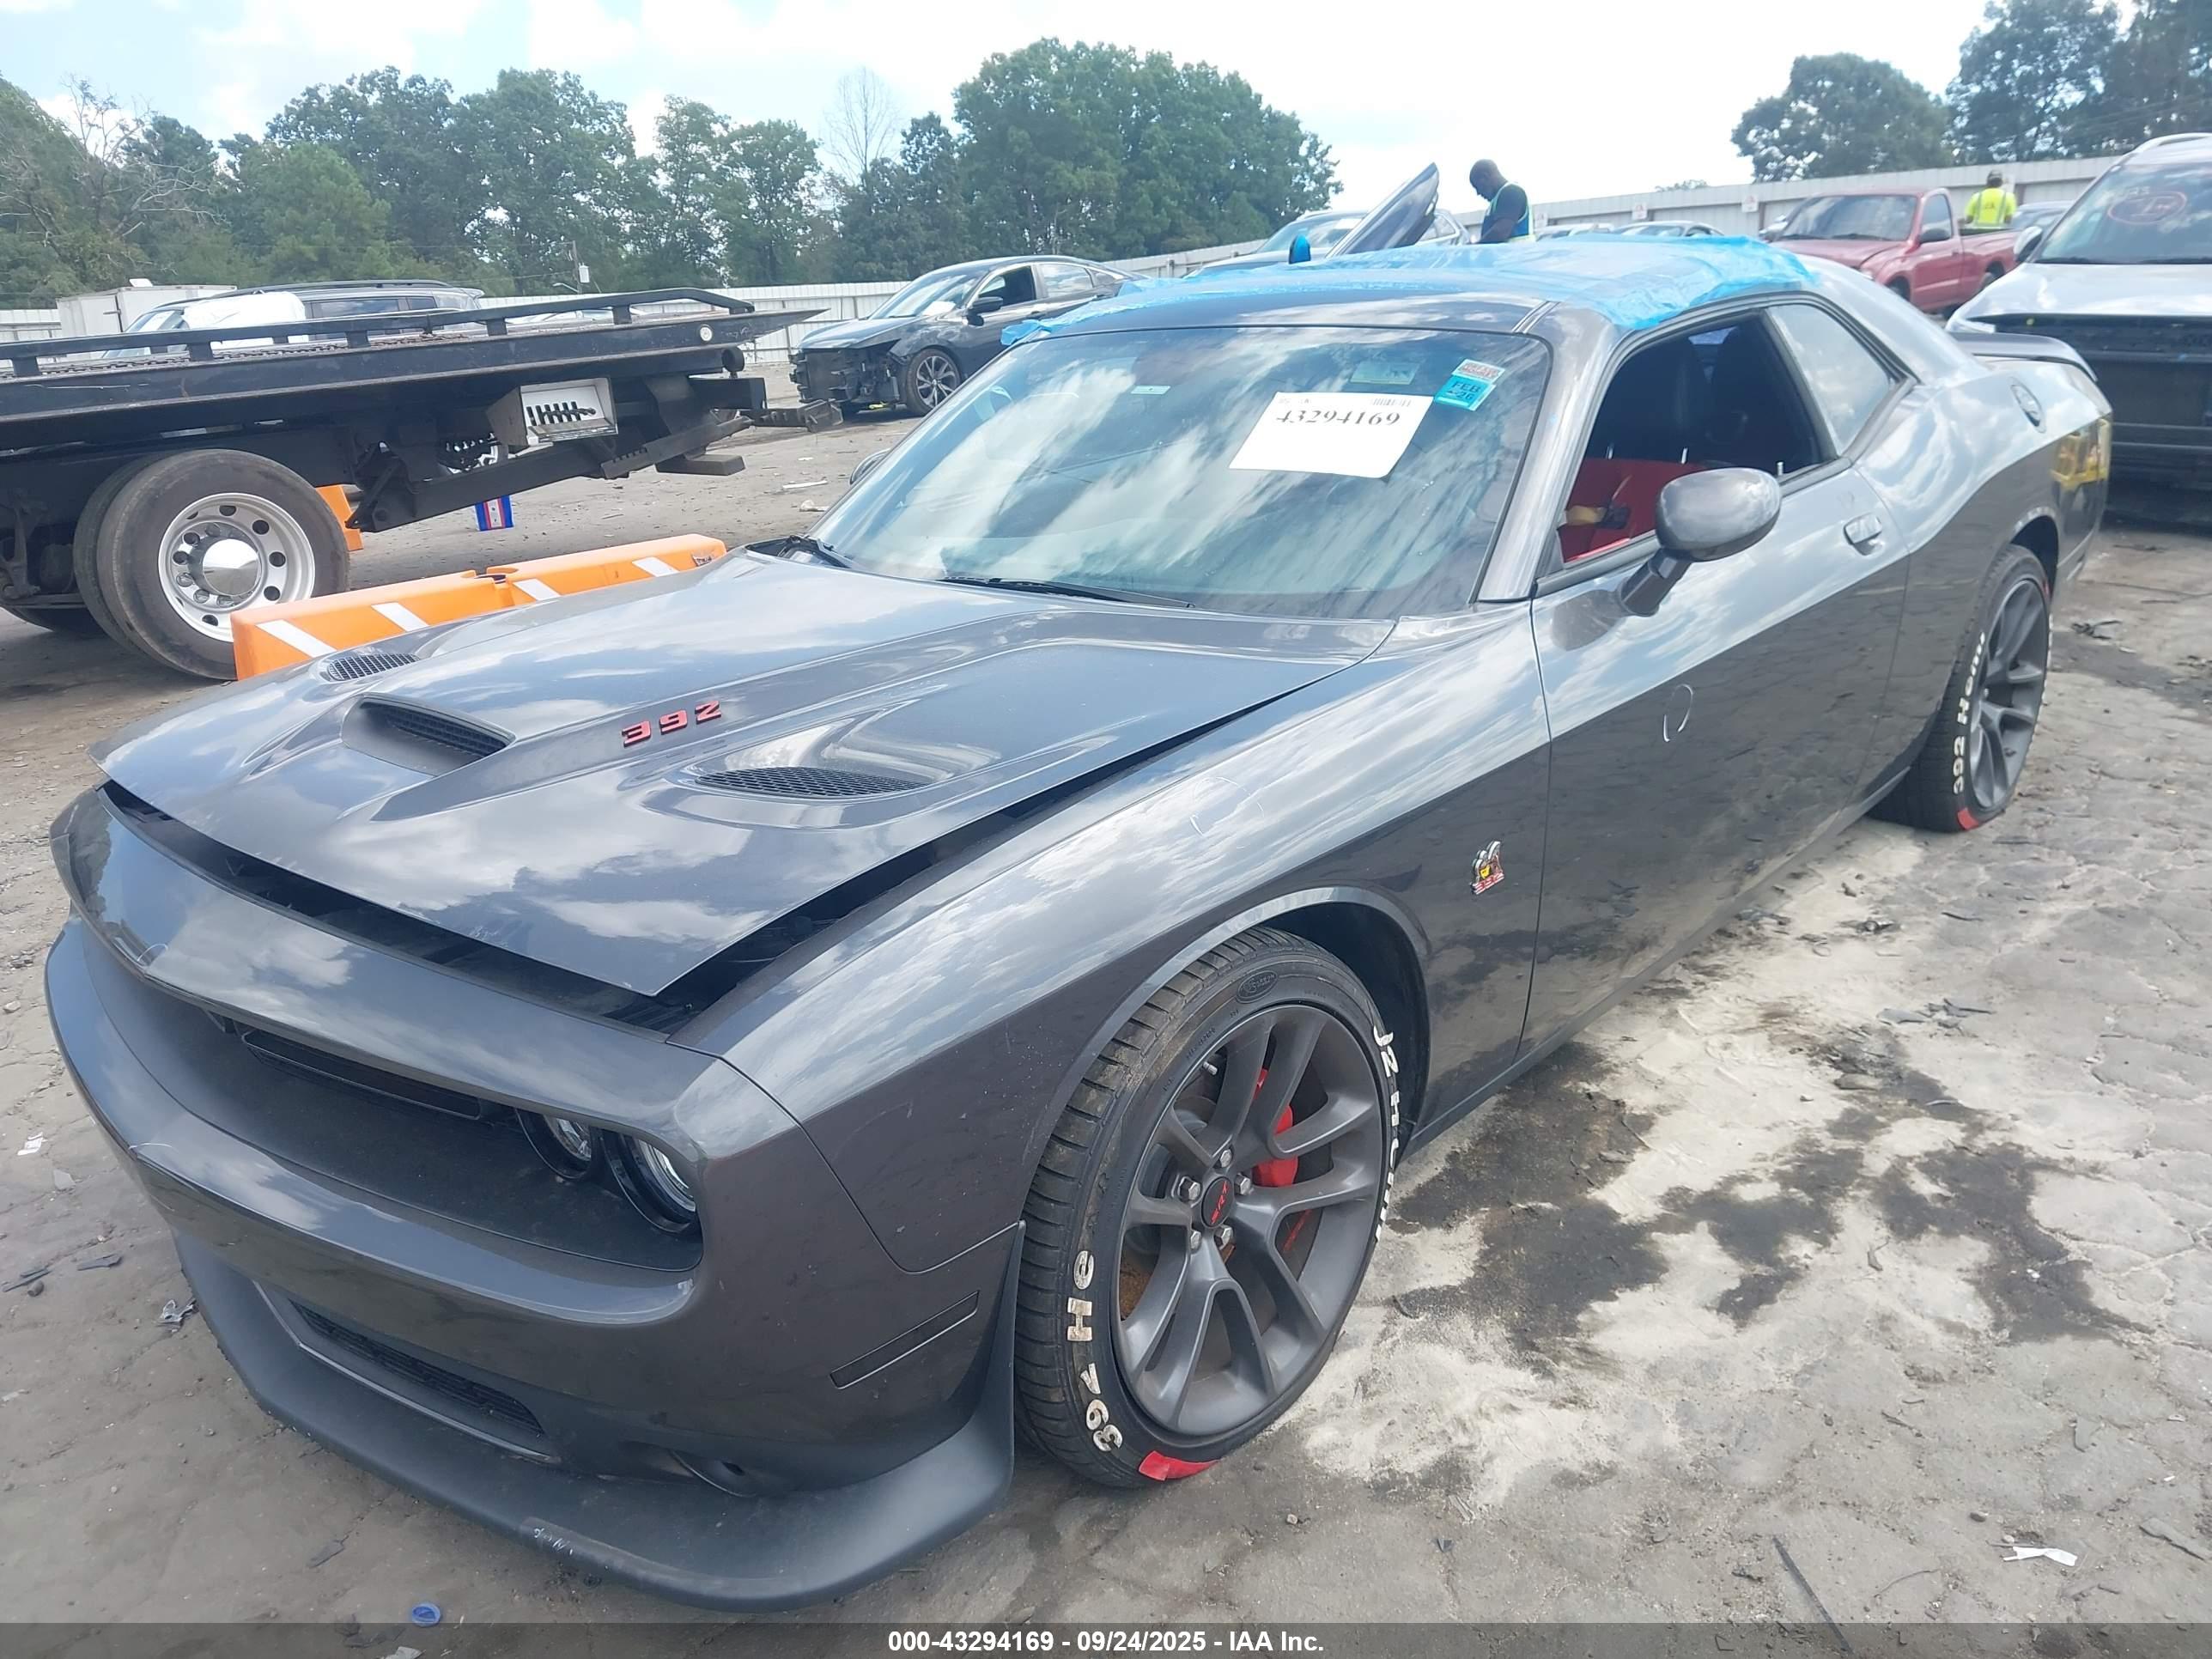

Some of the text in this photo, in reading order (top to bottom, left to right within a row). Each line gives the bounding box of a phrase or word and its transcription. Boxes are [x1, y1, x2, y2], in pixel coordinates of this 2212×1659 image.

[1450, 380, 1480, 392] FEB
[1276, 410, 1401, 426] 43294169
[621, 700, 722, 749] 392
[1953, 736, 1966, 795] 392
[1210, 1180, 1230, 1224] SRT
